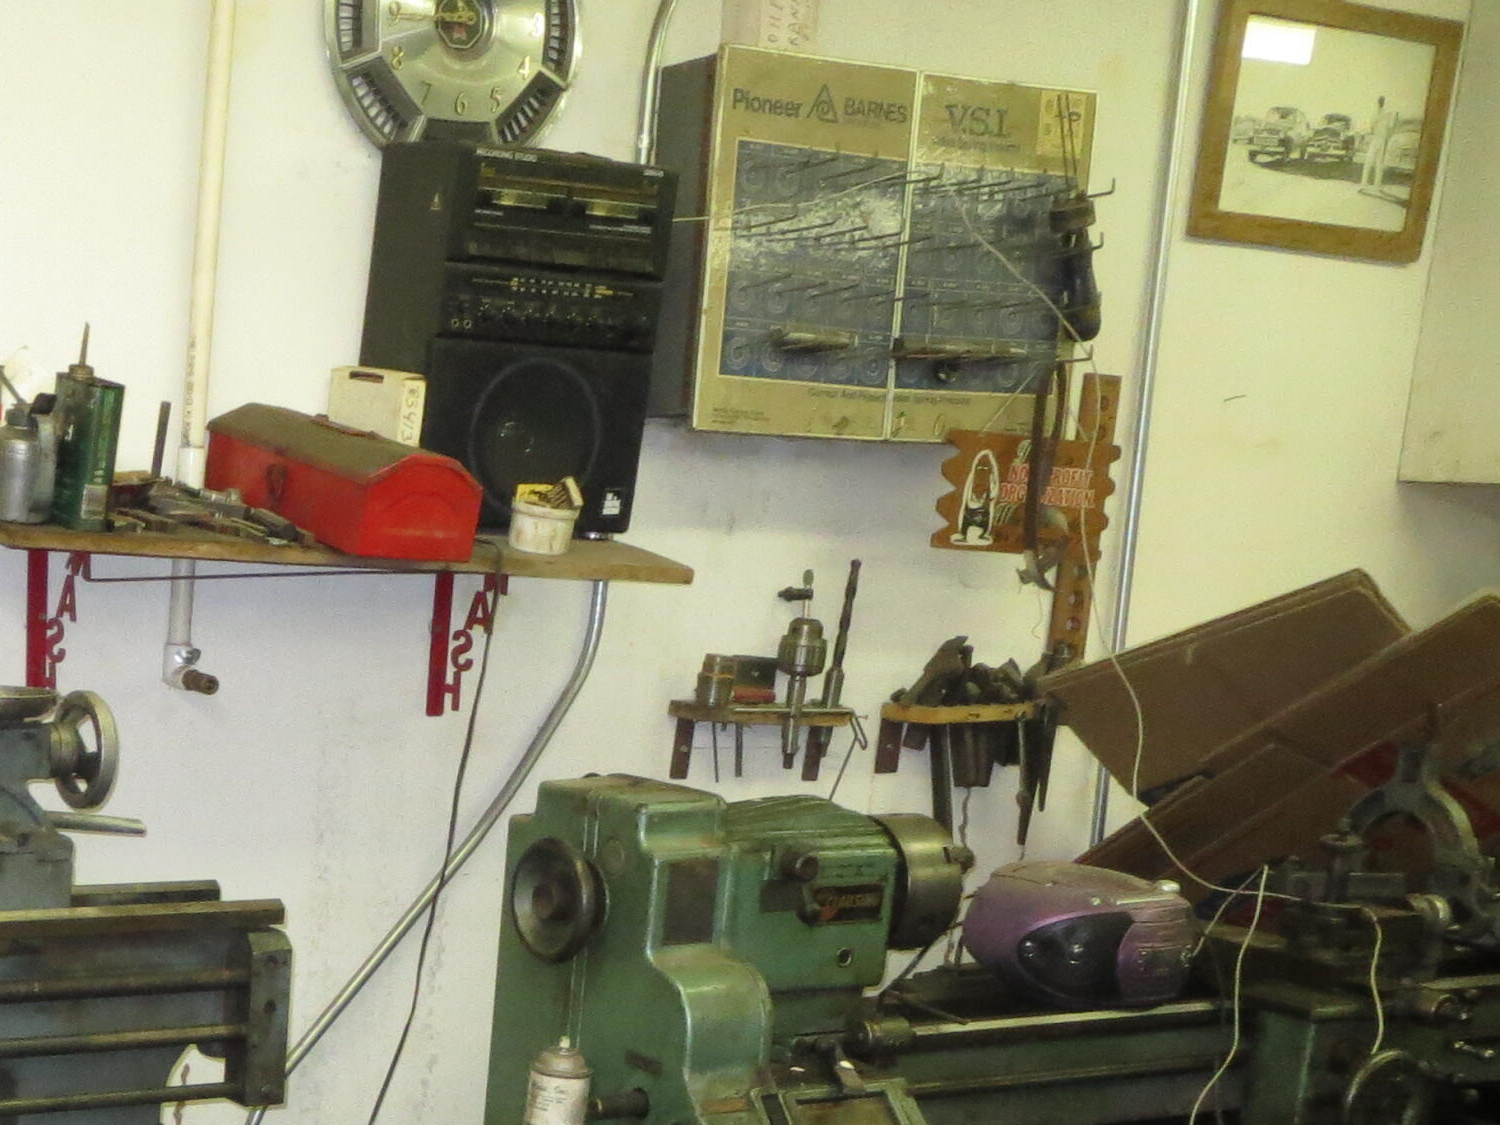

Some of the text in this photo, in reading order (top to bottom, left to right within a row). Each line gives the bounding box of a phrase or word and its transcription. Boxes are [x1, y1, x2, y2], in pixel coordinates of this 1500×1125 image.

[518, 55, 531, 81] 4
[454, 92, 468, 116] 6
[490, 87, 502, 113] 5
[731, 87, 908, 125] Pioneer BARNES
